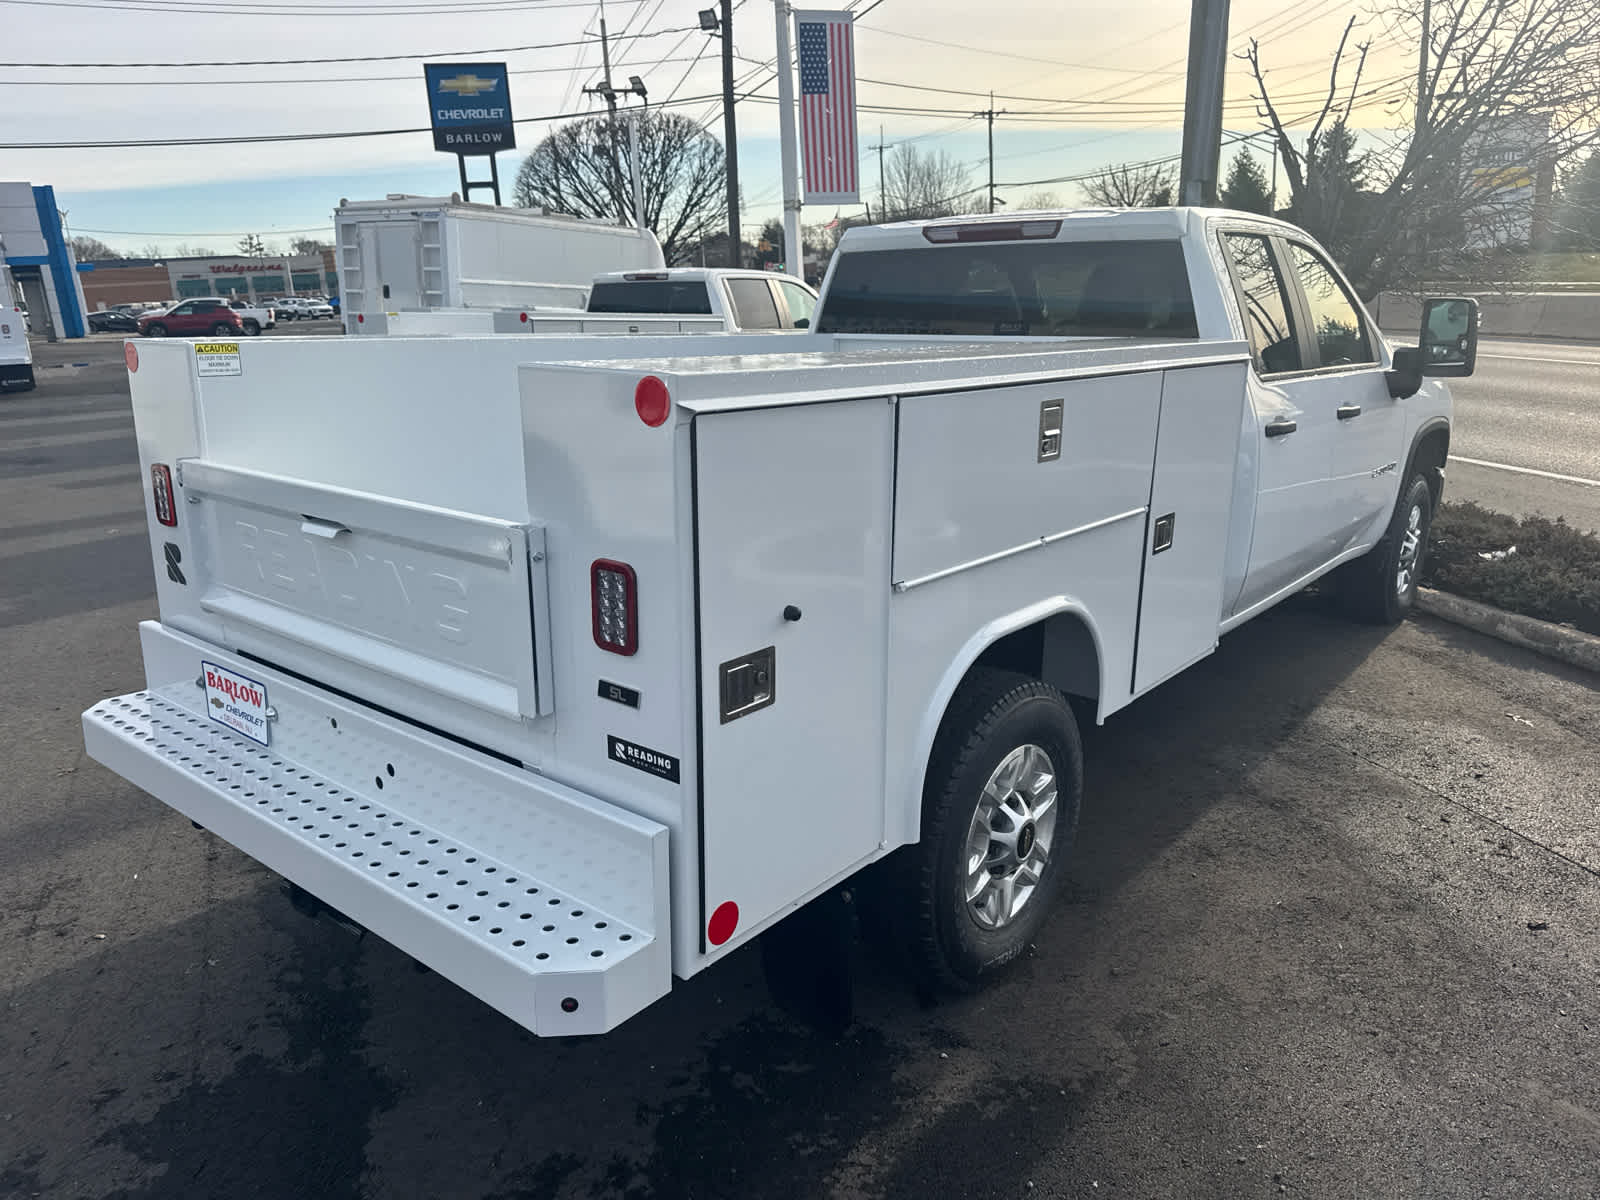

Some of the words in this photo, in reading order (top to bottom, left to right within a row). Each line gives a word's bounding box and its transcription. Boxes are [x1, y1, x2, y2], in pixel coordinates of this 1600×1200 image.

[437, 108, 504, 120] CHEVROLET
[446, 133, 502, 144] BARLOW
[209, 263, 284, 275] Walgreens
[204, 344, 238, 353] CAUTION
[207, 671, 263, 708] BARLOW
[609, 686, 627, 702] SL
[226, 704, 264, 727] CHEVROLET
[627, 746, 671, 769] READING
